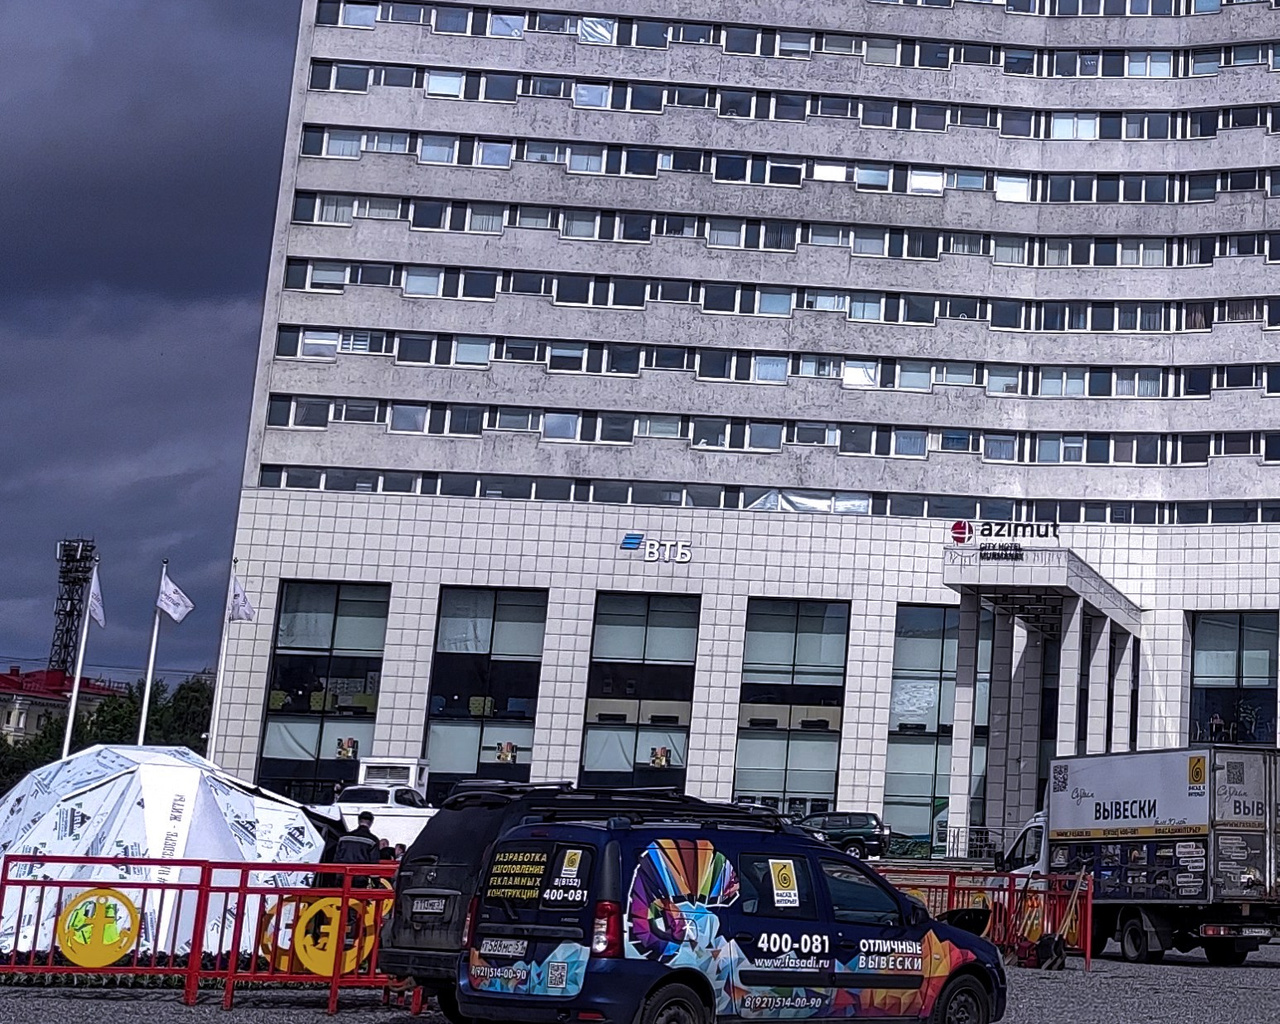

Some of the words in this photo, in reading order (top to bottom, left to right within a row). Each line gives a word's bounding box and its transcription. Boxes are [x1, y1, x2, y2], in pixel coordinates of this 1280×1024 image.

[980, 518, 1060, 538] azimut
[644, 539, 692, 563] ВТБ
[1094, 799, 1157, 820] ВЫВЕСКИ
[161, 831, 178, 860] ЕВЕРЕ
[495, 853, 547, 862] РАЗРАБОТКА
[492, 864, 545, 874] ИЗГОТОВЛЕНИЕ
[489, 876, 542, 886] РЕКЛАМНЫХ
[487, 887, 540, 899] КОНСТРУКЦИЙ
[543, 889, 588, 901] 400-081
[757, 933, 830, 953] 400-081
[859, 939, 922, 954] ОТЛИЧНЫЕ
[754, 955, 830, 969] www.fasadi.ru
[858, 955, 922, 970] ВЫВЕСКИ
[745, 996, 822, 1010] 8(921)514-00-90
